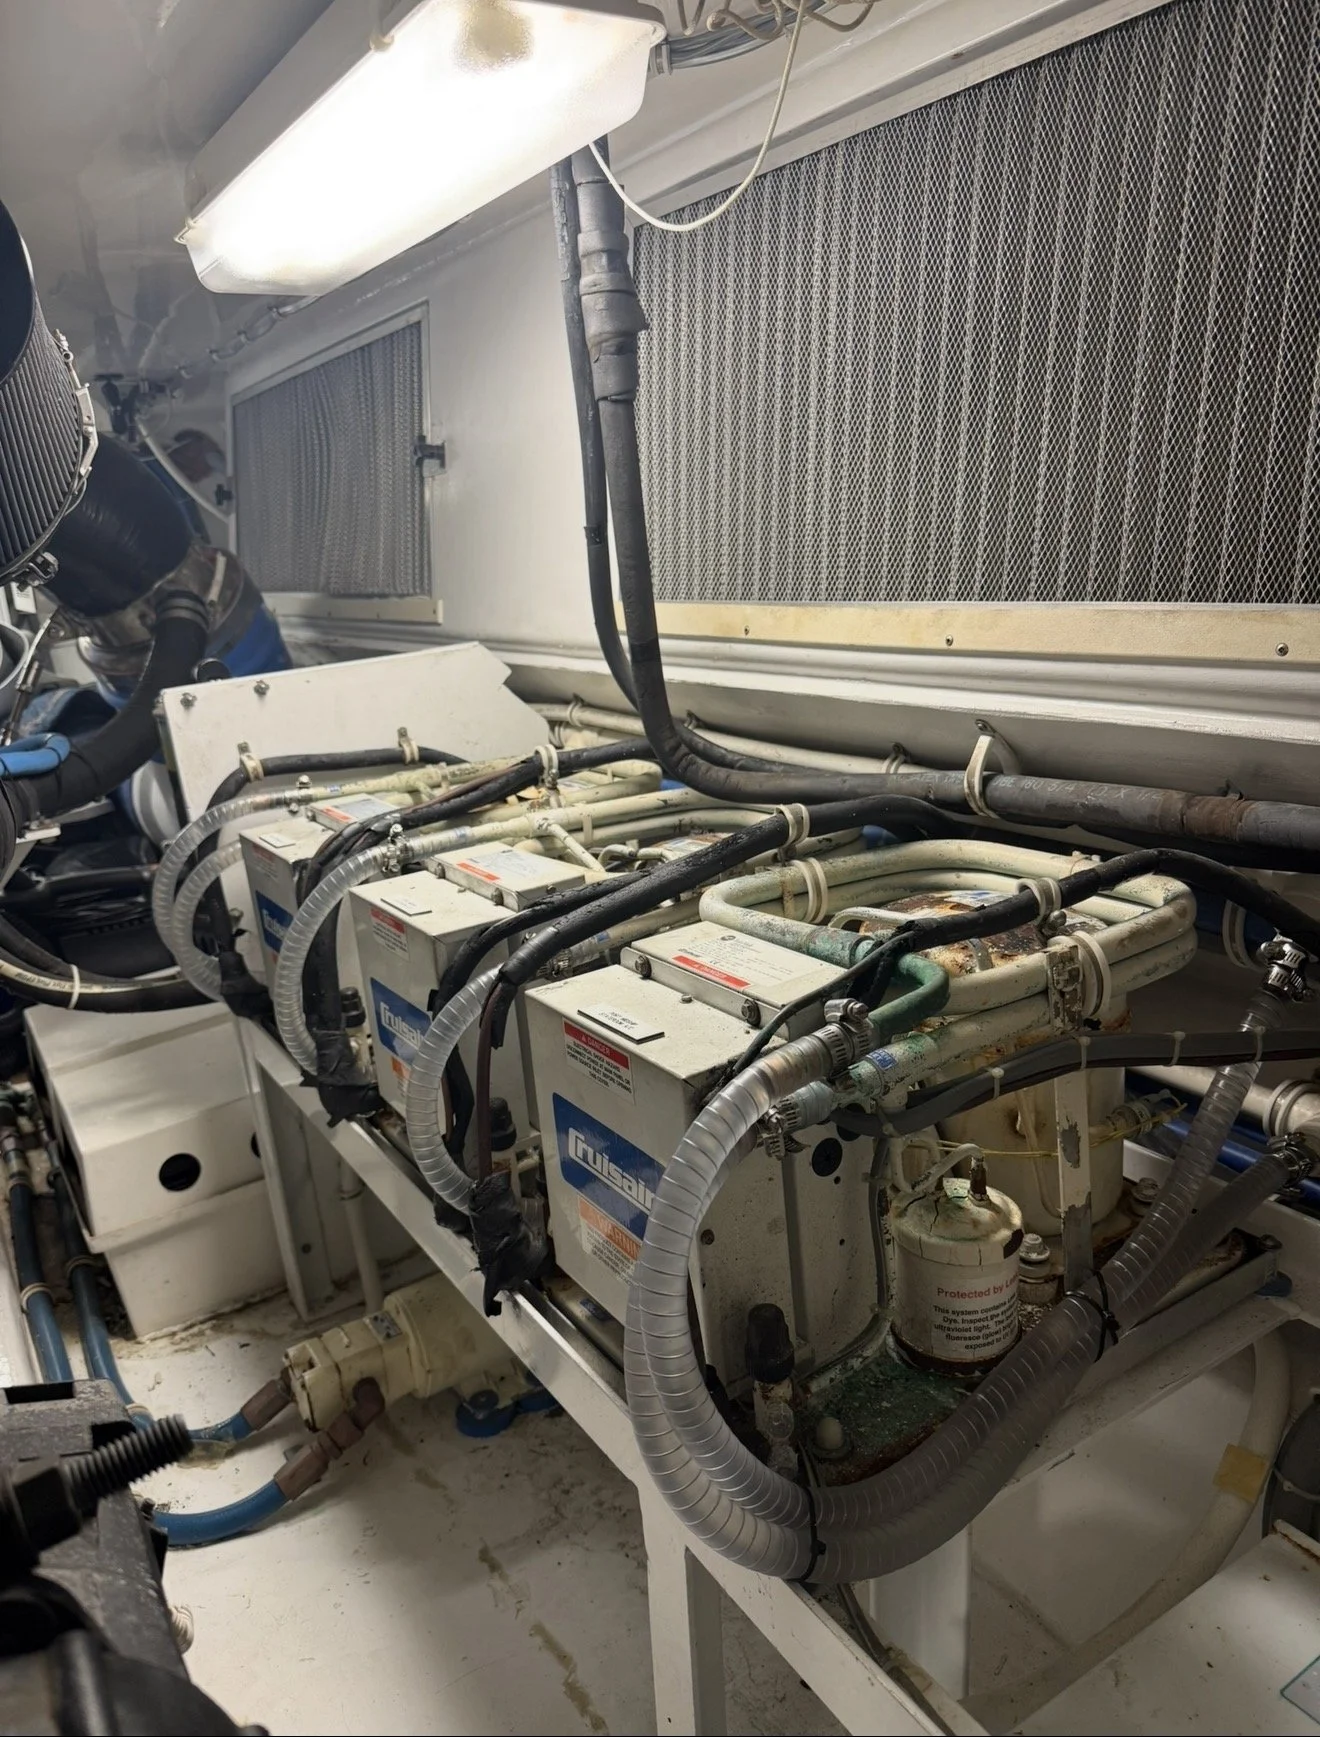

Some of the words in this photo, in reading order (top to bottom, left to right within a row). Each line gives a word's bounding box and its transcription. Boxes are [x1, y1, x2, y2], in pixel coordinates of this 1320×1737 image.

[380, 1001, 421, 1051] Cruisai
[568, 1127, 654, 1217] Cruisair
[596, 1210, 641, 1260] WARNIN
[937, 1287, 991, 1299] Protected
[993, 1284, 1004, 1294] by
[933, 1305, 950, 1314] This
[951, 1309, 979, 1317] system
[980, 1302, 1007, 1312] contains
[934, 1323, 972, 1333] ultraviolet
[961, 1316, 989, 1325] Inspect
[965, 1339, 995, 1350] exposed
